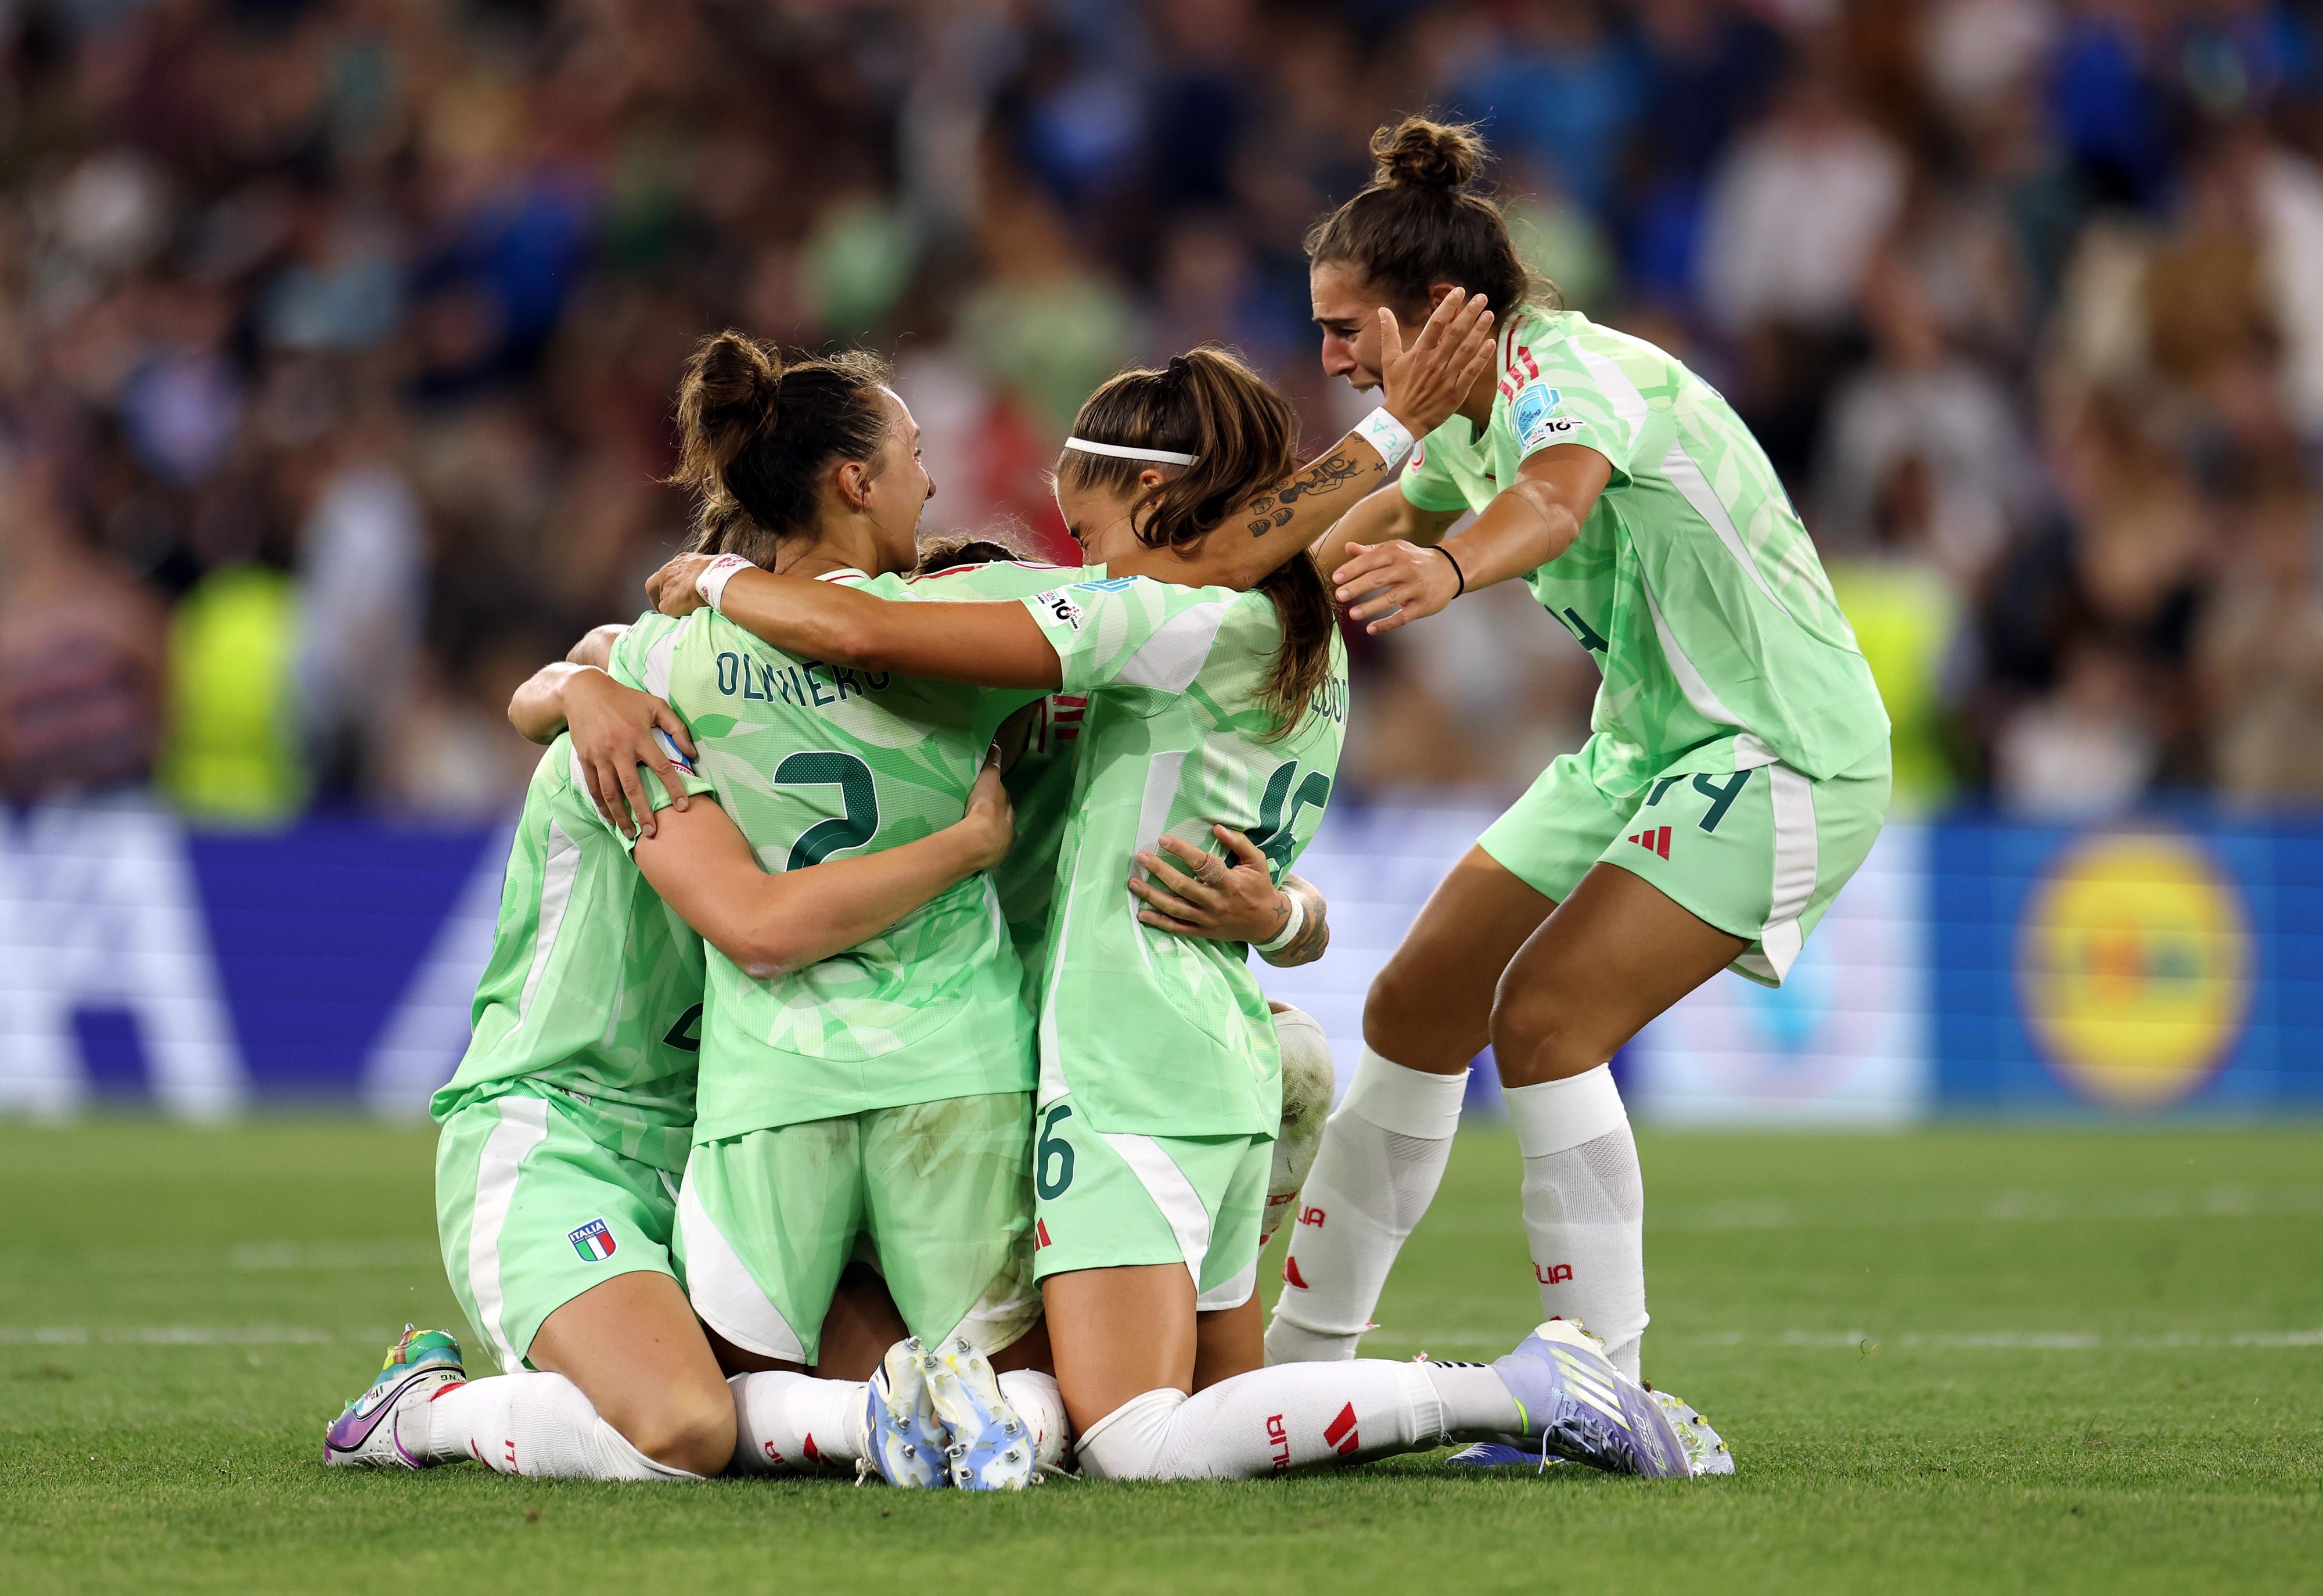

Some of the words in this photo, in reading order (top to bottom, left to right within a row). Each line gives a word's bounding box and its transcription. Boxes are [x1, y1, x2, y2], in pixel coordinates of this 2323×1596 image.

[773, 751, 880, 872] 2
[1036, 1105, 1076, 1200] 6
[569, 1221, 605, 1242] ITALIA
